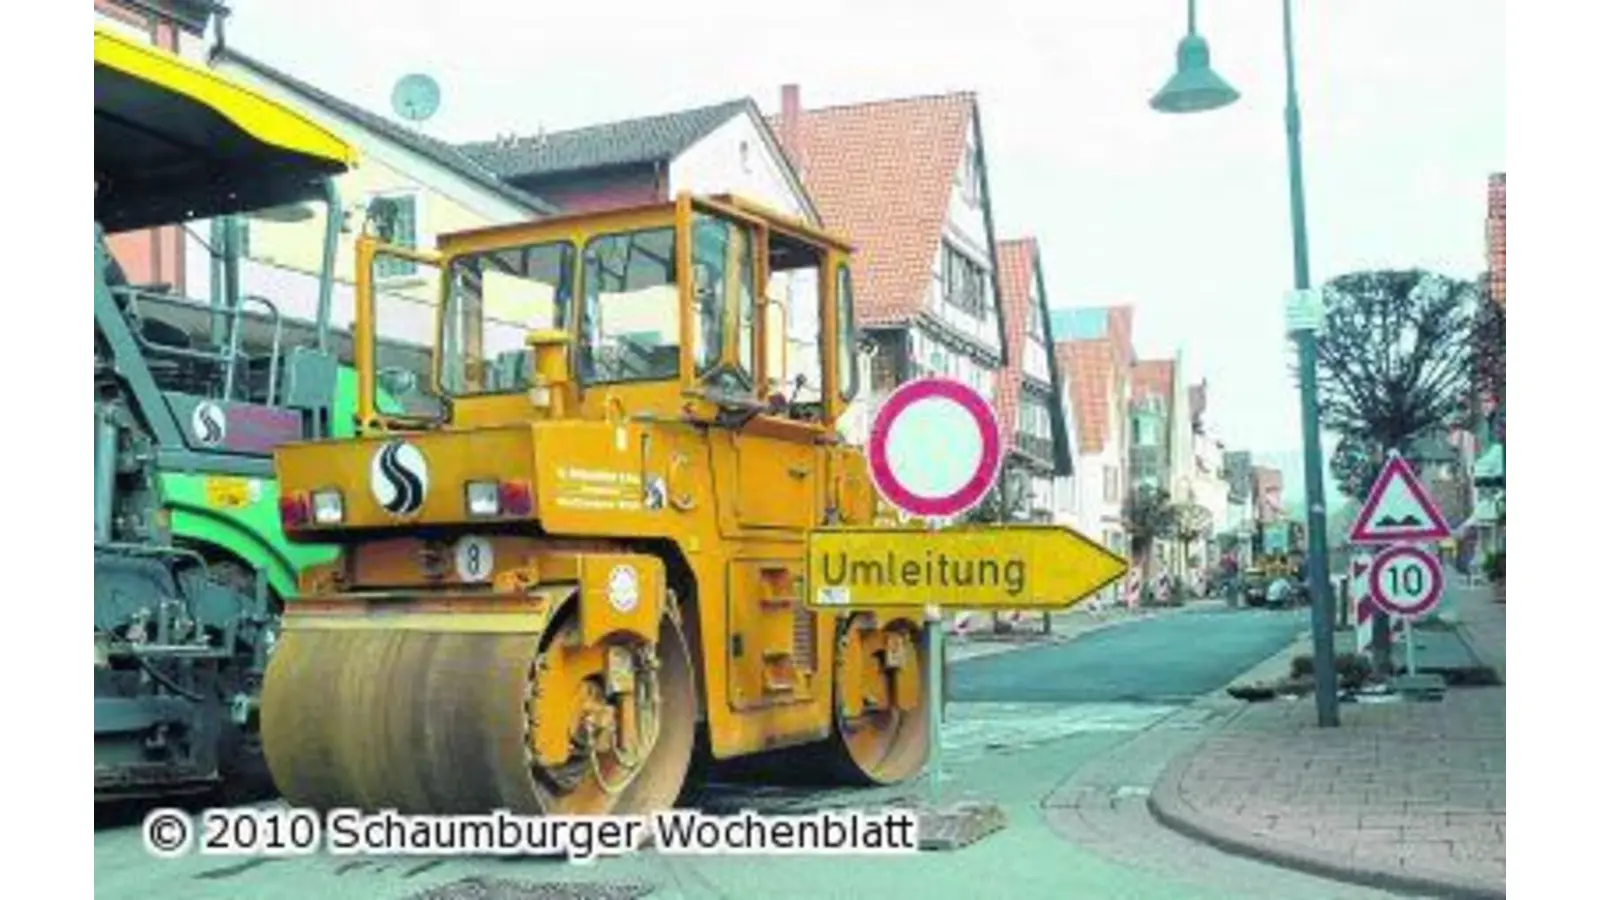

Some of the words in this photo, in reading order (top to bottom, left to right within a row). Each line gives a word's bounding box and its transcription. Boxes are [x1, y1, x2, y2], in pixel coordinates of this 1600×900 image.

[468, 543, 481, 575] 8
[822, 550, 1026, 595] Umleitung
[1388, 564, 1423, 597] 10
